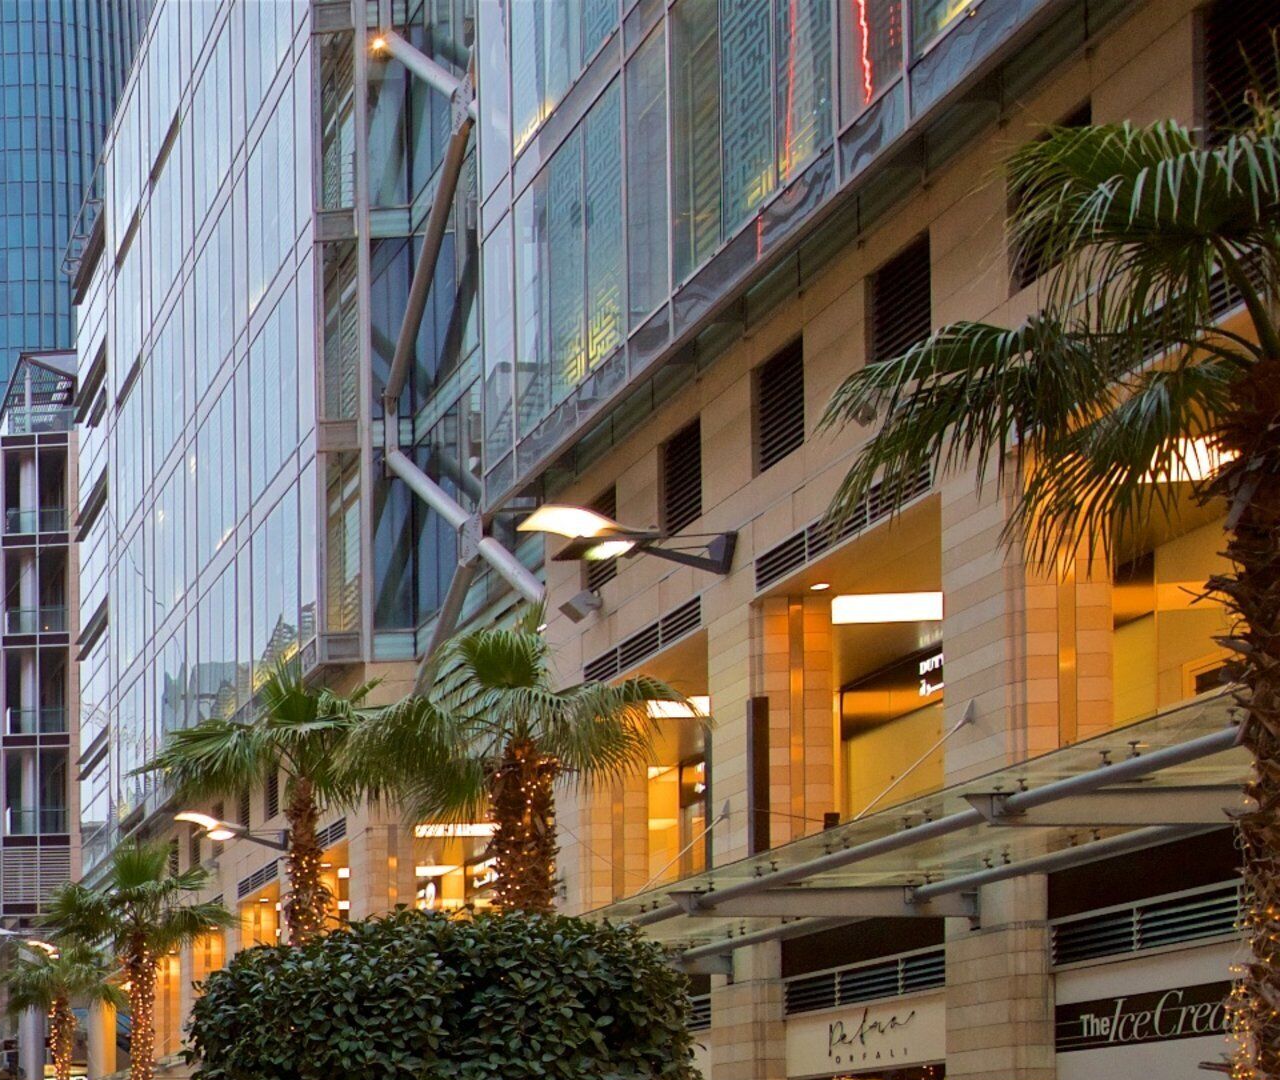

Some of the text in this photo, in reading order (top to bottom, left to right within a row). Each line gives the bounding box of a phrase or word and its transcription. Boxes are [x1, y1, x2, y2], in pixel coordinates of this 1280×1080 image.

[1080, 1013, 1111, 1038] The
[1108, 997, 1149, 1043] Ice
[835, 1047, 908, 1065] ORFALI
